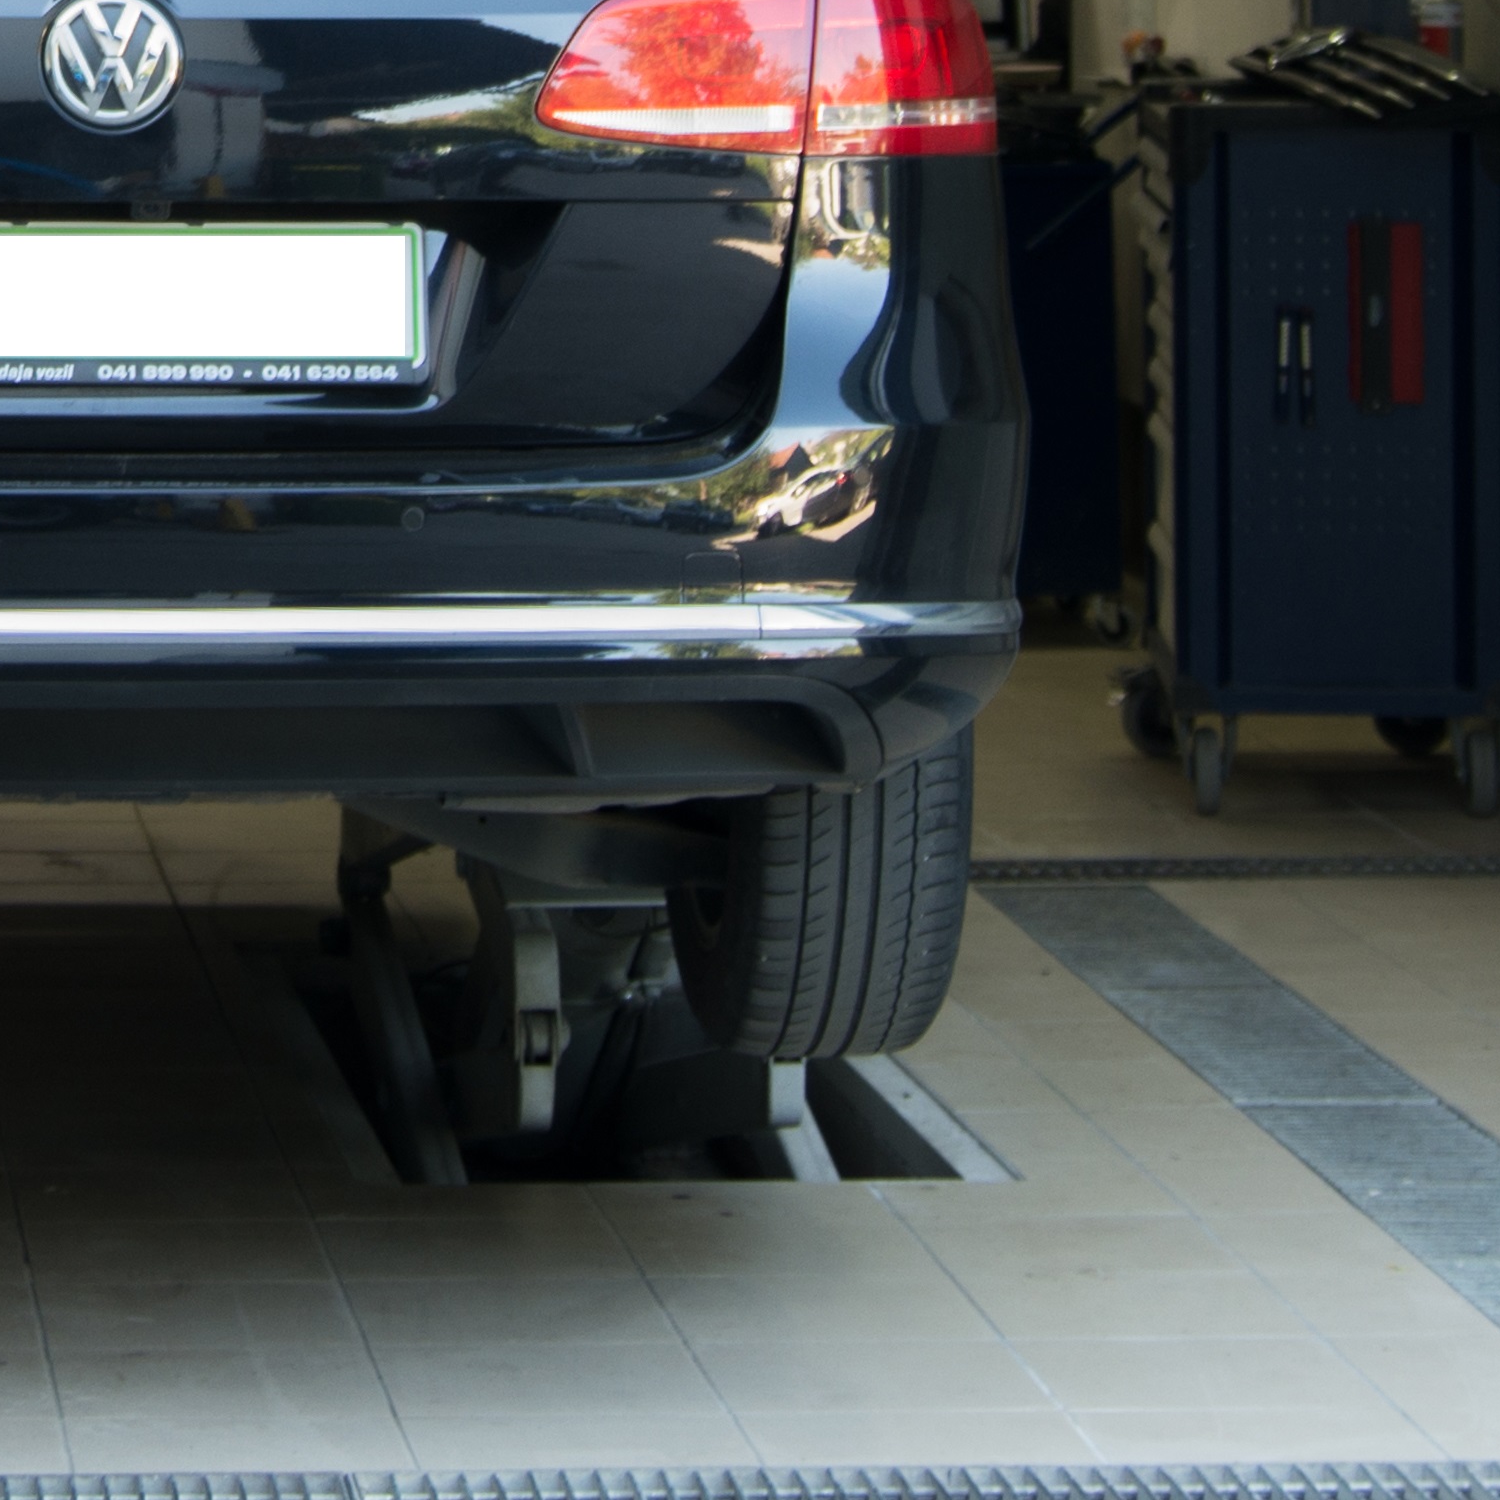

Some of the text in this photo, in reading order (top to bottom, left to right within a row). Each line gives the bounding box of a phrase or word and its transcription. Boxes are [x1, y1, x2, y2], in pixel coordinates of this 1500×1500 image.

[35, 363, 75, 381] vozil
[97, 364, 136, 381] 041
[261, 364, 300, 381] 041
[306, 364, 350, 381] 630
[353, 364, 399, 381] 564
